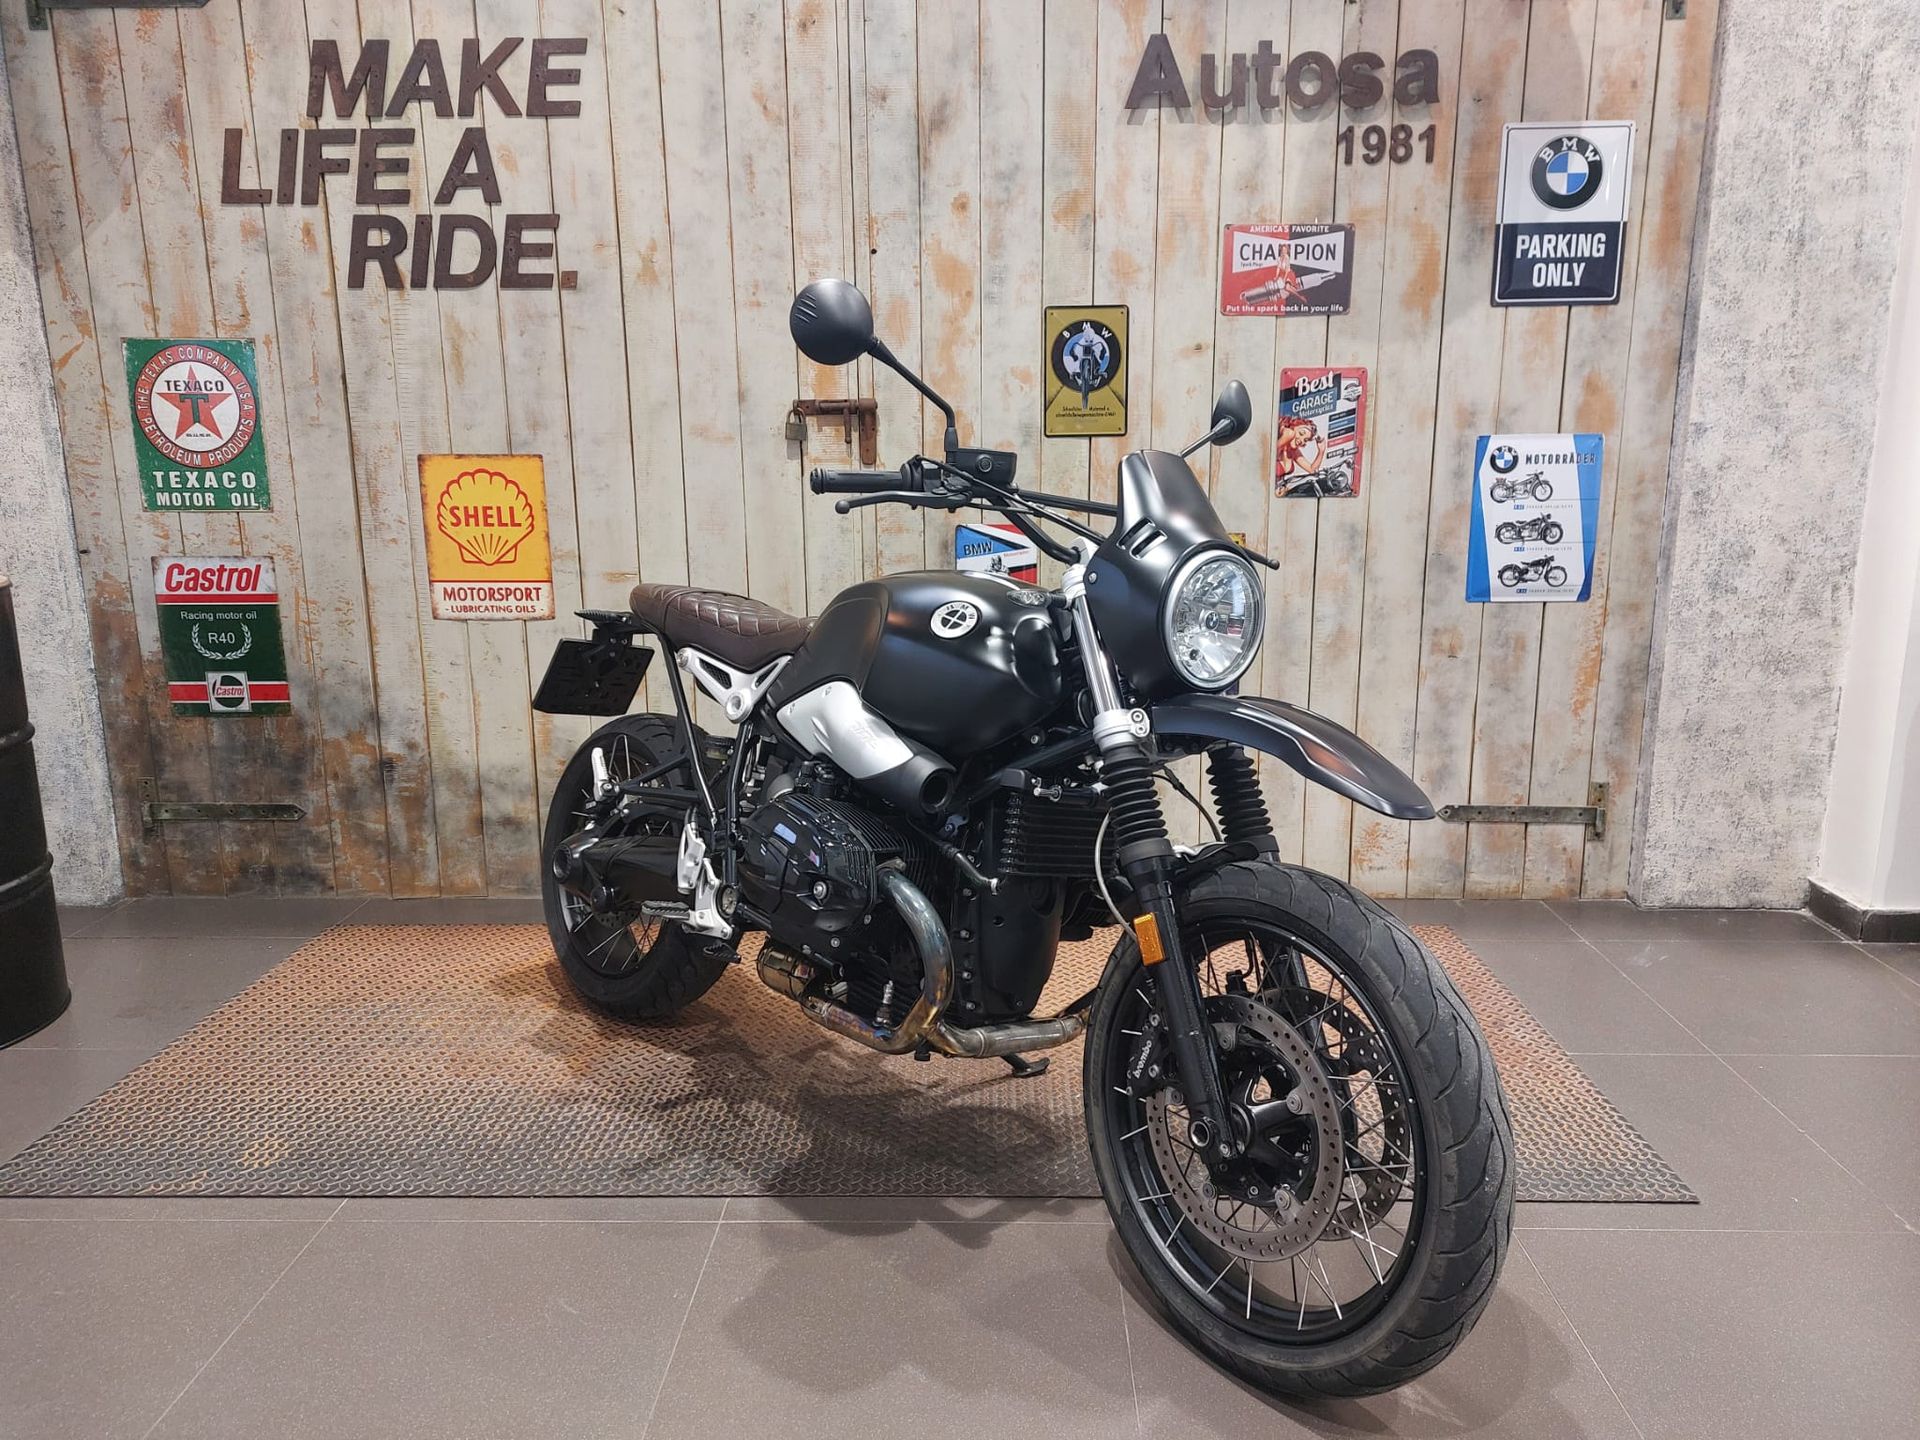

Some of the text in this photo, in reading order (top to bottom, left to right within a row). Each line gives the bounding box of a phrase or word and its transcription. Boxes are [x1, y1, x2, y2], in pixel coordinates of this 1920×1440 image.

[306, 37, 588, 117] MAKE
[1124, 33, 1440, 109] Autosa
[1338, 124, 1436, 165] 1981
[1538, 137, 1600, 163] BMW
[221, 127, 502, 205] LIFE A
[1249, 225, 1329, 233] AMERICA'S FAVORITE
[347, 214, 578, 289] RIDE.
[1515, 233, 1607, 259] PARKING
[1532, 262, 1586, 288] ONLY
[1226, 304, 1344, 314] Put the spark back in your life
[1062, 321, 1112, 339] BMW
[141, 351, 174, 381] TEXAS
[179, 347, 238, 377] COMPANY
[164, 380, 225, 392] TEXACO
[1295, 370, 1334, 396] Best
[137, 387, 149, 411] THE
[1292, 391, 1334, 413] GARAGE
[142, 417, 254, 466] PETROLEUM PRODUCTS
[1525, 452, 1597, 465] MOTORRÄDER
[152, 471, 257, 489] TEXACO
[156, 492, 259, 507] MOTOR OIL
[449, 505, 522, 528] SHELL
[963, 541, 994, 556] BMW
[165, 563, 262, 592] Castrol
[443, 587, 542, 601] MOTORSPORT
[180, 611, 257, 621] Racing motor oil
[450, 604, 536, 613] LUBRICATING OILS
[208, 632, 235, 644] R40
[216, 686, 245, 696] Castrol
[1132, 1040, 1152, 1078] brembo
